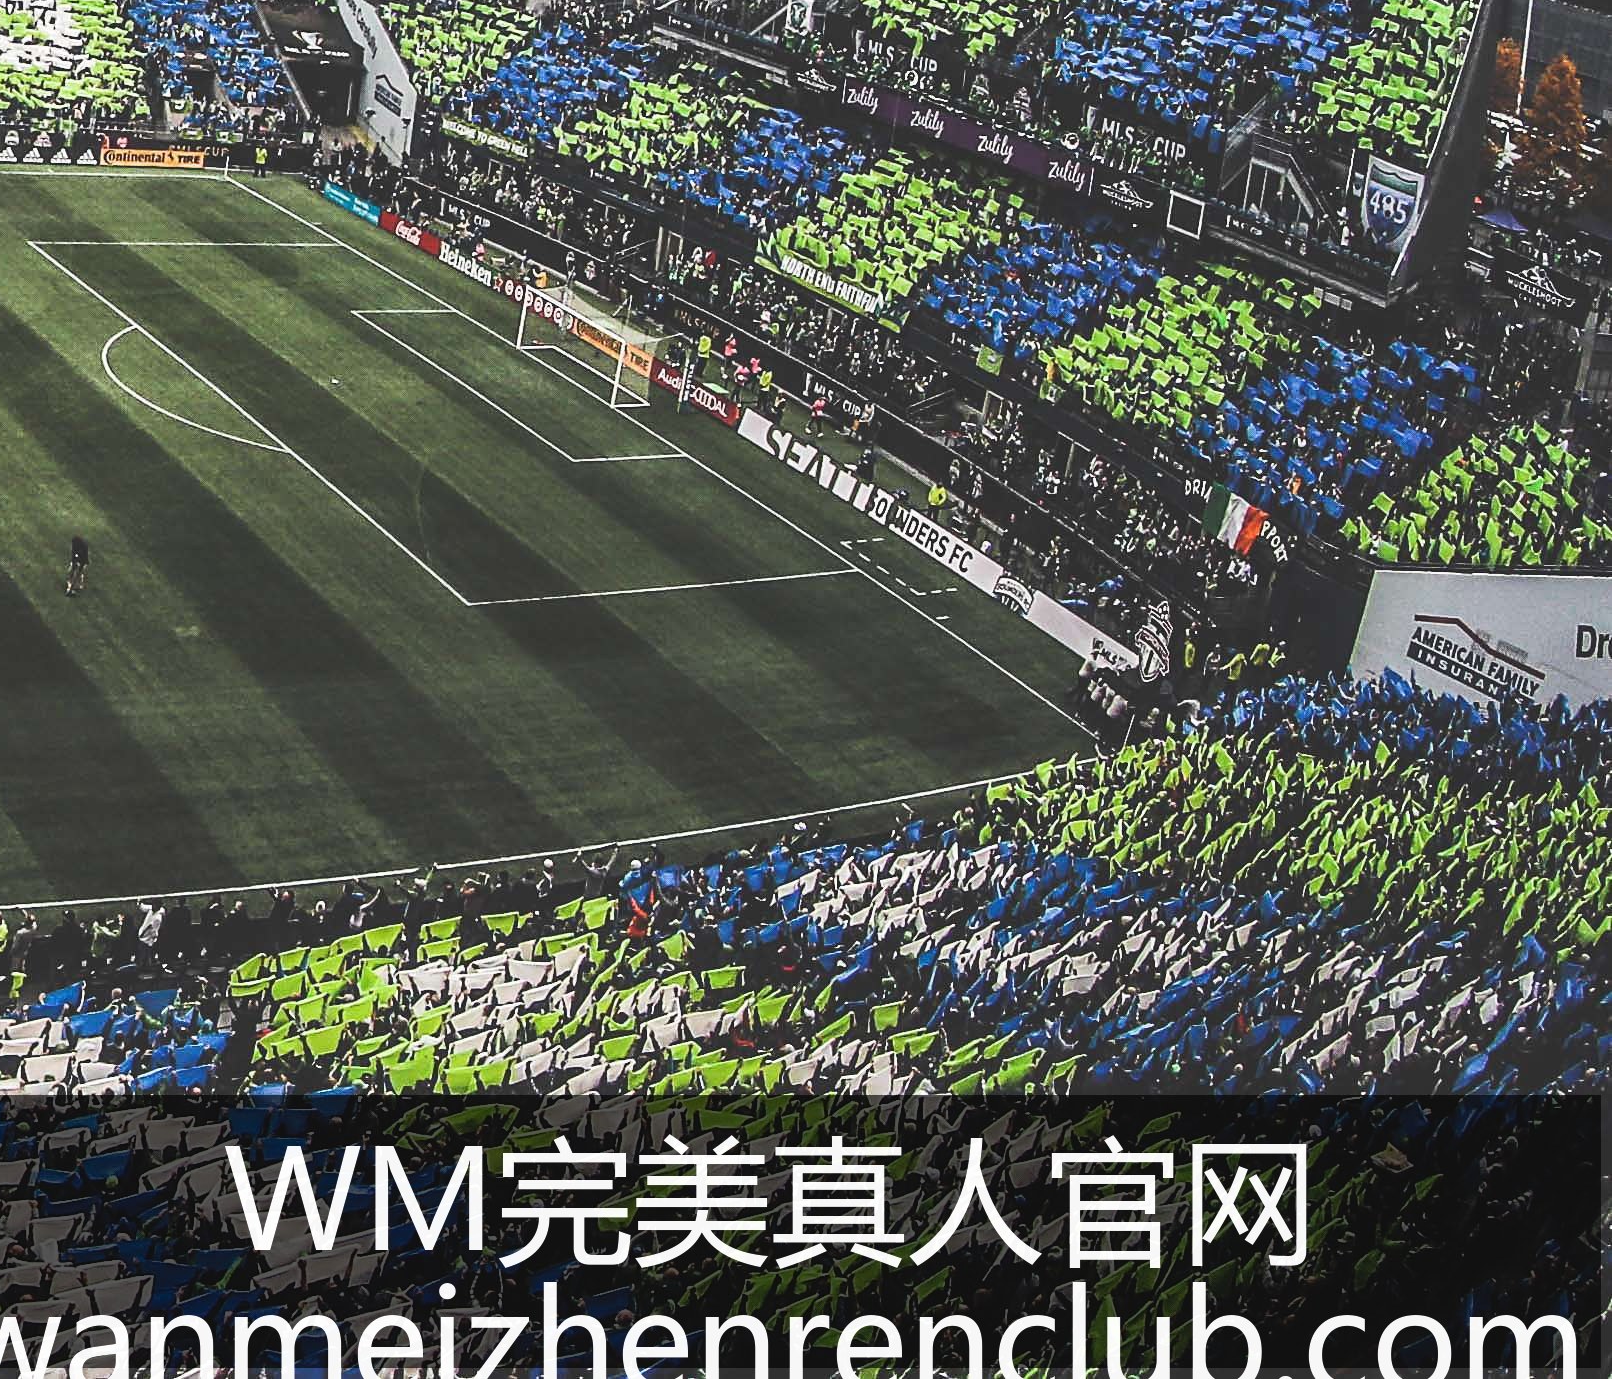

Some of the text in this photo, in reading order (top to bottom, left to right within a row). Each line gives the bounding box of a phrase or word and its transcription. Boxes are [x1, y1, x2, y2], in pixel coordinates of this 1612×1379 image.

[477, 130, 487, 143] TO
[1102, 118, 1186, 160] MLS CUP
[103, 148, 164, 165] Continental
[177, 155, 200, 165] TIRE
[1369, 193, 1408, 224] 485
[439, 239, 492, 287] Heineken
[780, 254, 813, 284] NORTH
[658, 367, 683, 390] Audi
[949, 546, 973, 573] FC
[1412, 626, 1540, 698] AMERICAN FAMILY
[1417, 648, 1508, 698] INSURAN
